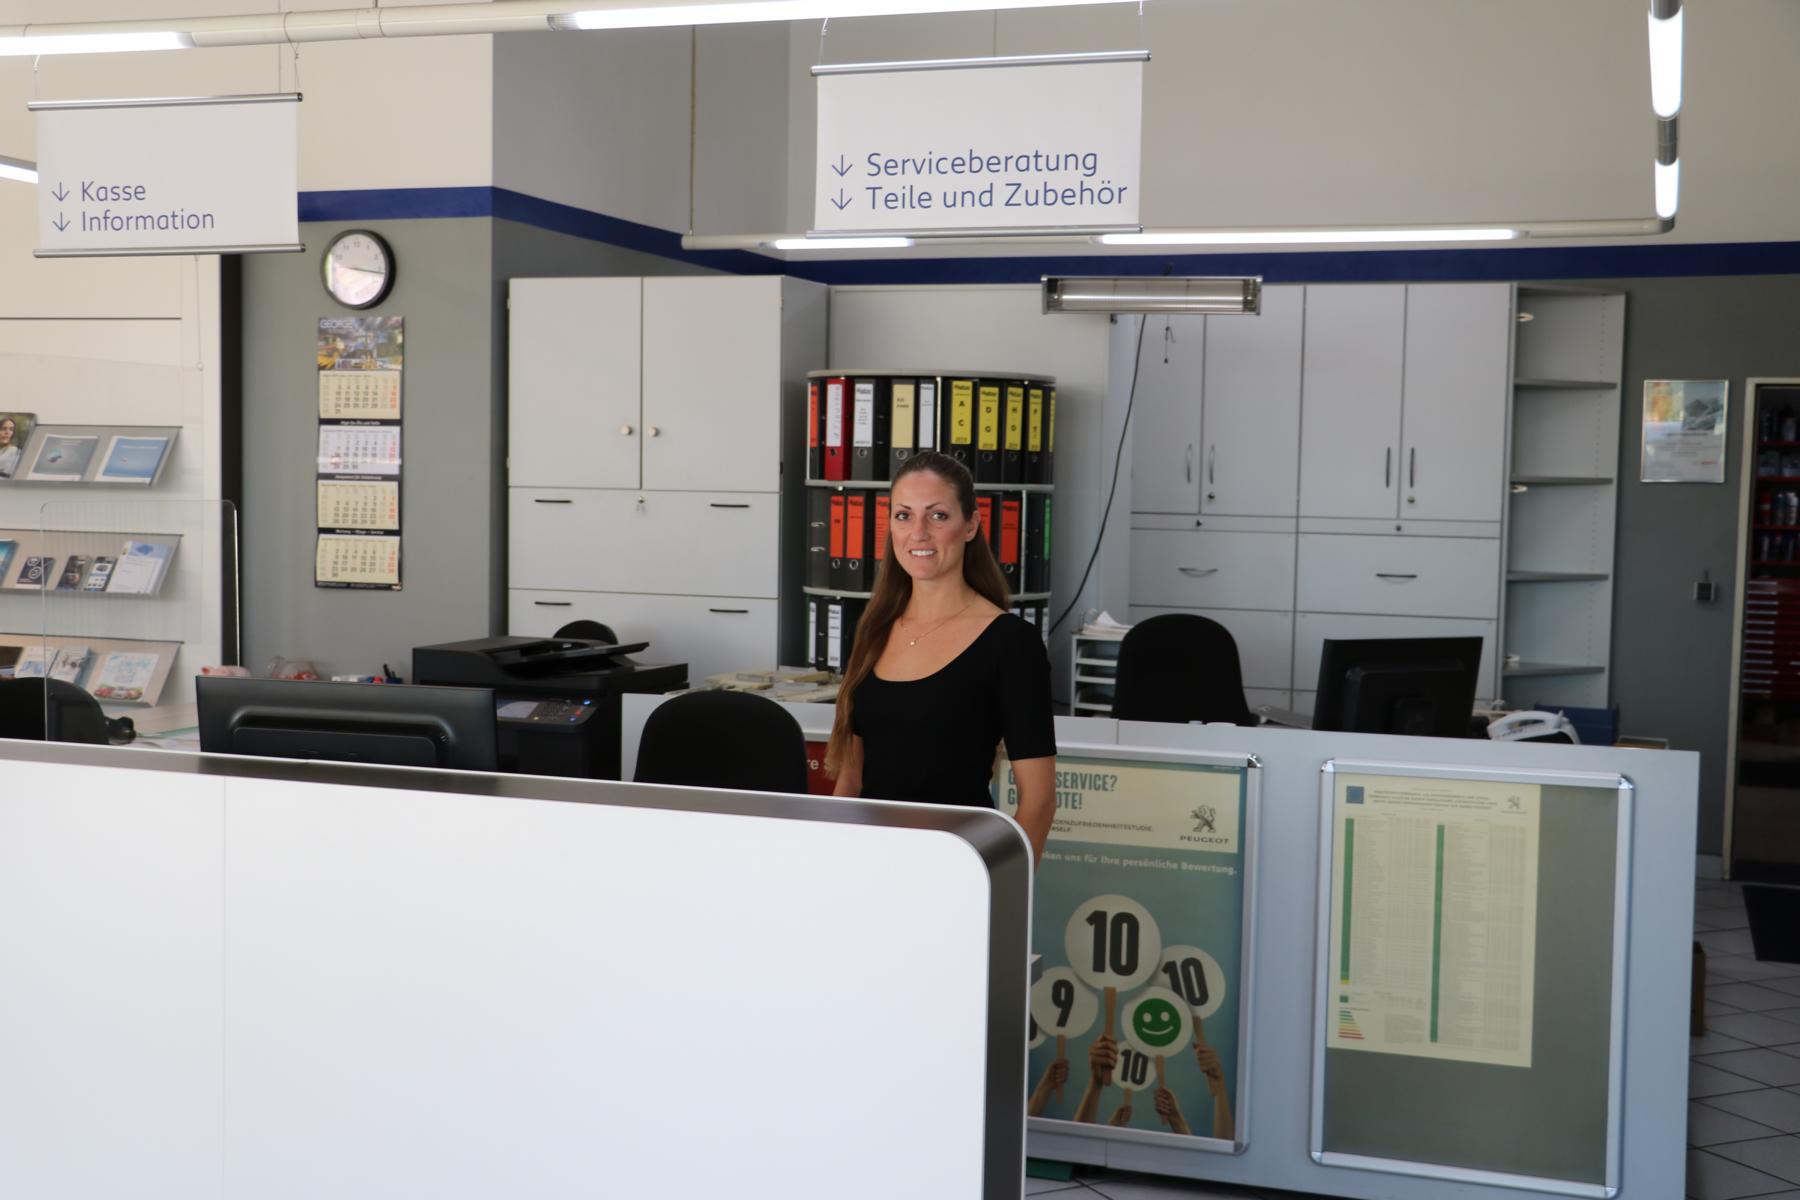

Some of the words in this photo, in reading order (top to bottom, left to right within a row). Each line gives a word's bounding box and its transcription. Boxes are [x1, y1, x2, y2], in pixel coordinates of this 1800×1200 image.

[866, 149, 1098, 177] Serviceberatung
[81, 180, 146, 202] Kasse
[866, 186, 932, 210] Teile
[943, 183, 994, 208] und
[1004, 180, 1128, 207] Zubehör
[82, 208, 215, 232] Information
[1056, 791, 1082, 809] OTE!
[1180, 835, 1229, 844] PEUGEOT
[1084, 853, 1098, 863] für
[1101, 855, 1120, 865] Ihre
[1086, 910, 1139, 976] 10
[1161, 957, 1209, 1007] 10
[1052, 979, 1074, 1028] 9
[1121, 1049, 1148, 1086] 10
